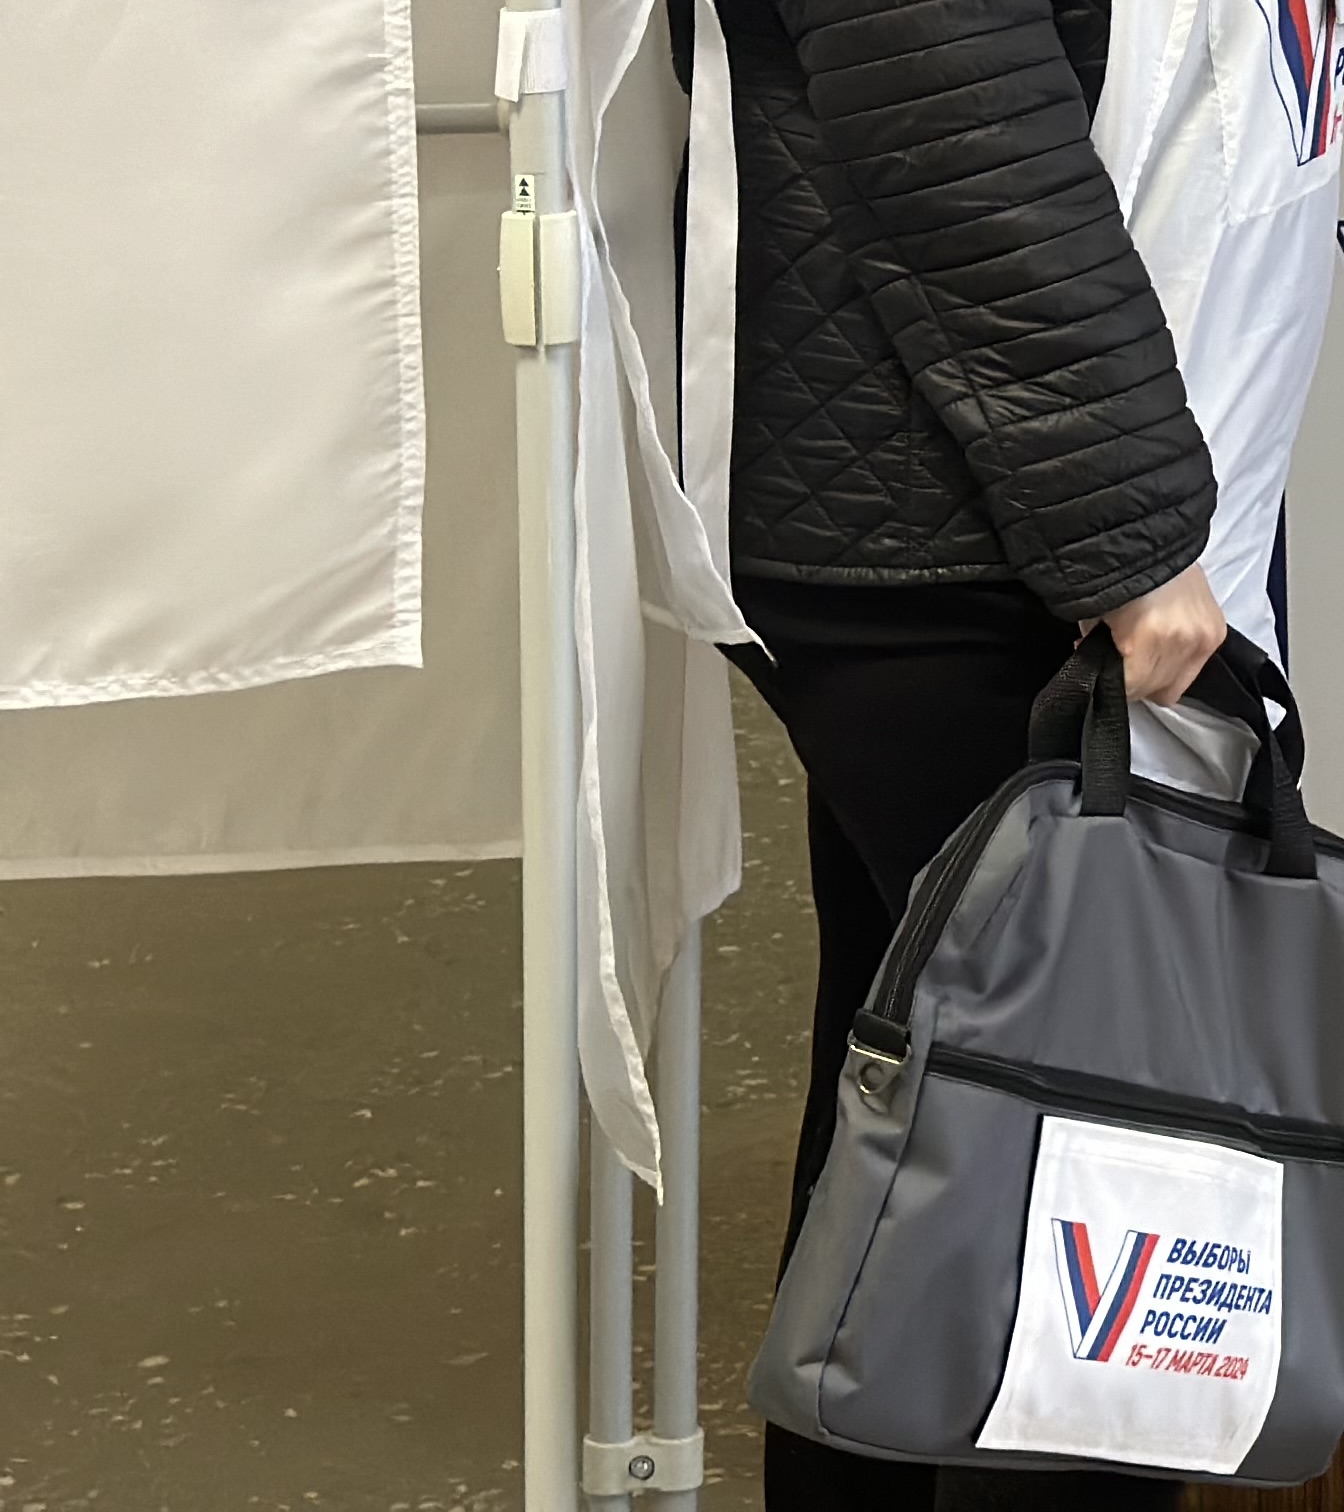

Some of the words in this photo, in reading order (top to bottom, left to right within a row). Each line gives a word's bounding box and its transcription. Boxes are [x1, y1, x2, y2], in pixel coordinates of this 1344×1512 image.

[1166, 1237, 1252, 1275] ВЫБОРЫ
[1152, 1273, 1274, 1316] ПРЕЗИДЕНТА
[1139, 1309, 1228, 1345] РОССИИ
[1169, 1347, 1216, 1377] МАРТА
[1213, 1355, 1250, 1381] 2024
